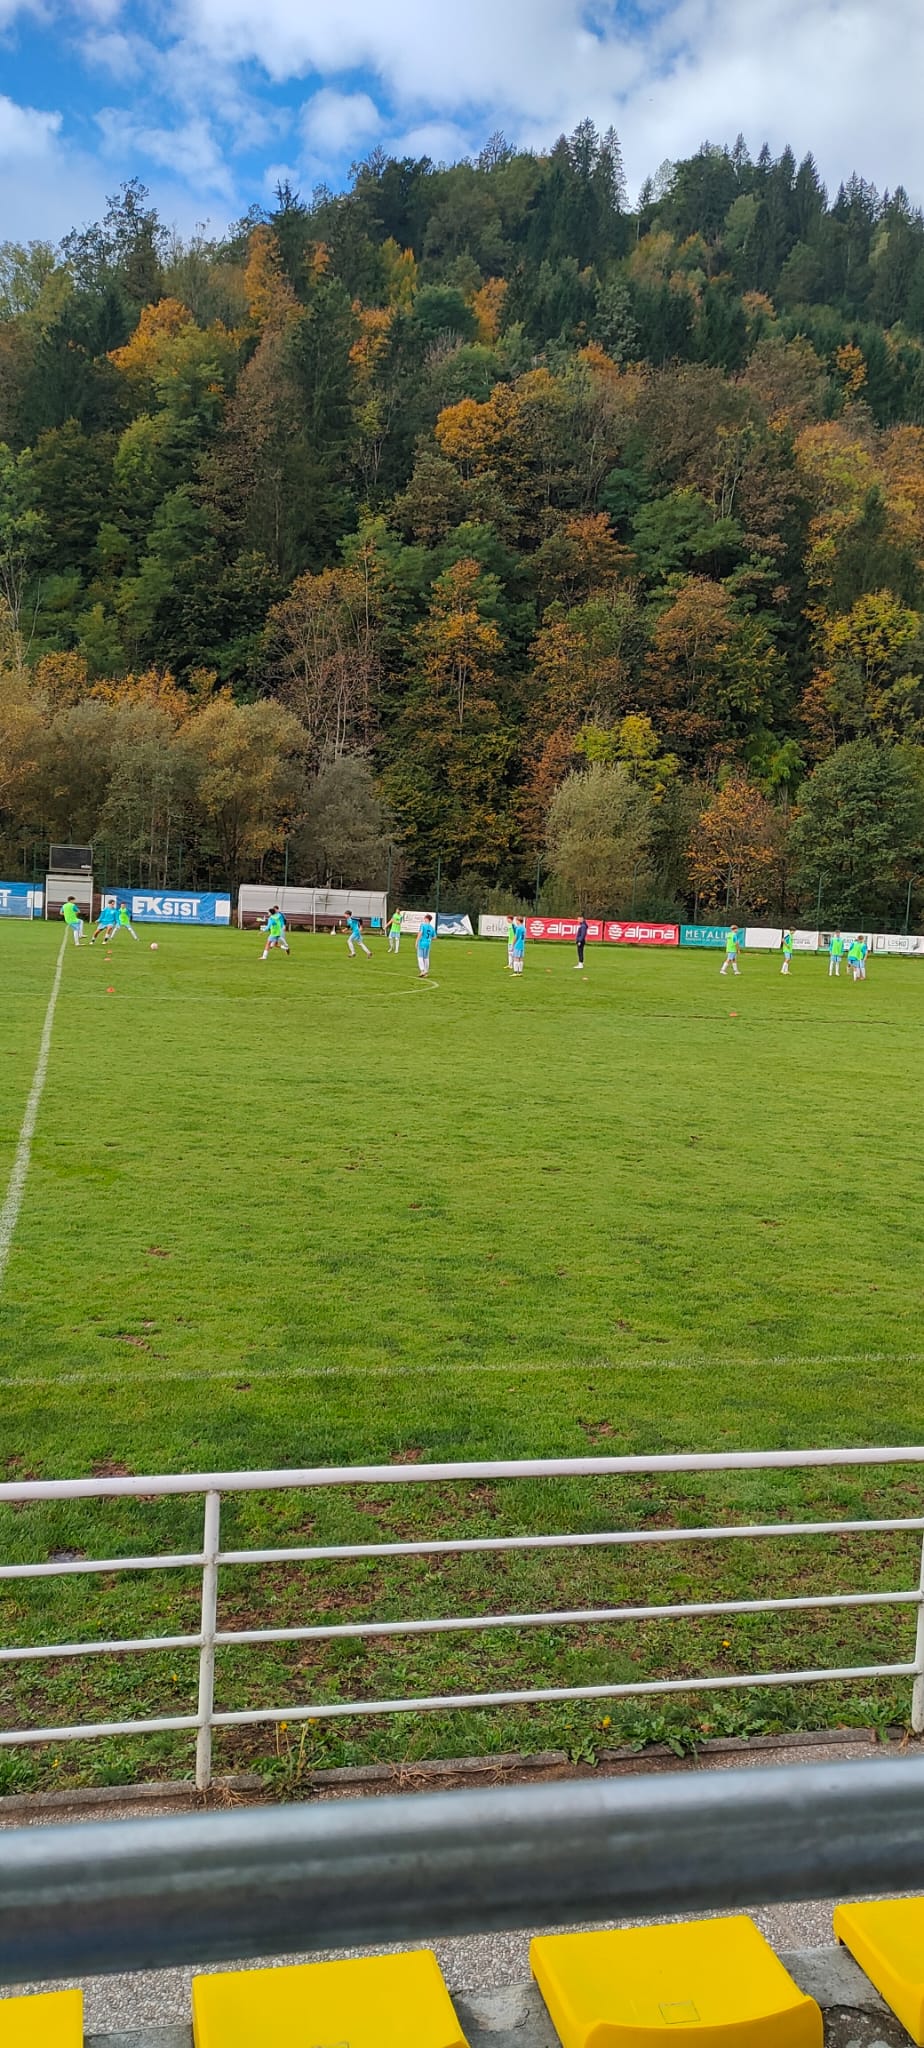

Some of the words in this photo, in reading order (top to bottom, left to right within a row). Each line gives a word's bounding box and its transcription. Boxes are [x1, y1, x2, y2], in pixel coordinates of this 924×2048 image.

[132, 896, 200, 916] EKSIST
[547, 922, 599, 936] alpia
[624, 926, 675, 940] alpina
